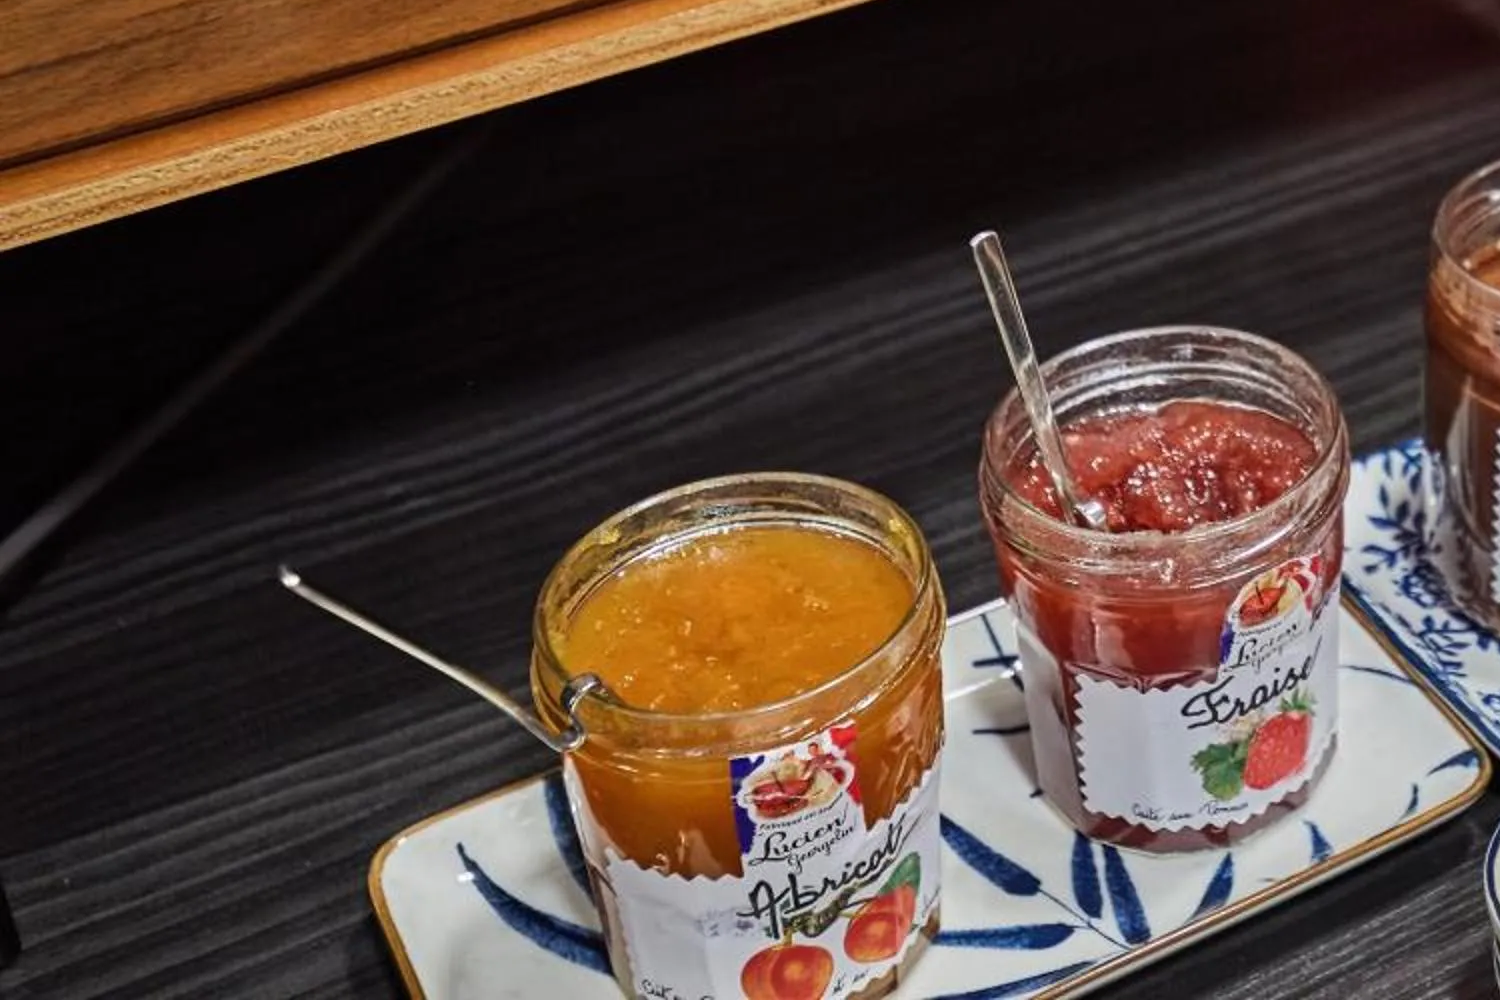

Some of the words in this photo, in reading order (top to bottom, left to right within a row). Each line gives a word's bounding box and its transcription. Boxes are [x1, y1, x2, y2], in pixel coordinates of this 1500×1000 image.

[1181, 635, 1323, 730] Fraise
[736, 812, 923, 940] Abricot
[748, 800, 848, 866] Lucien
